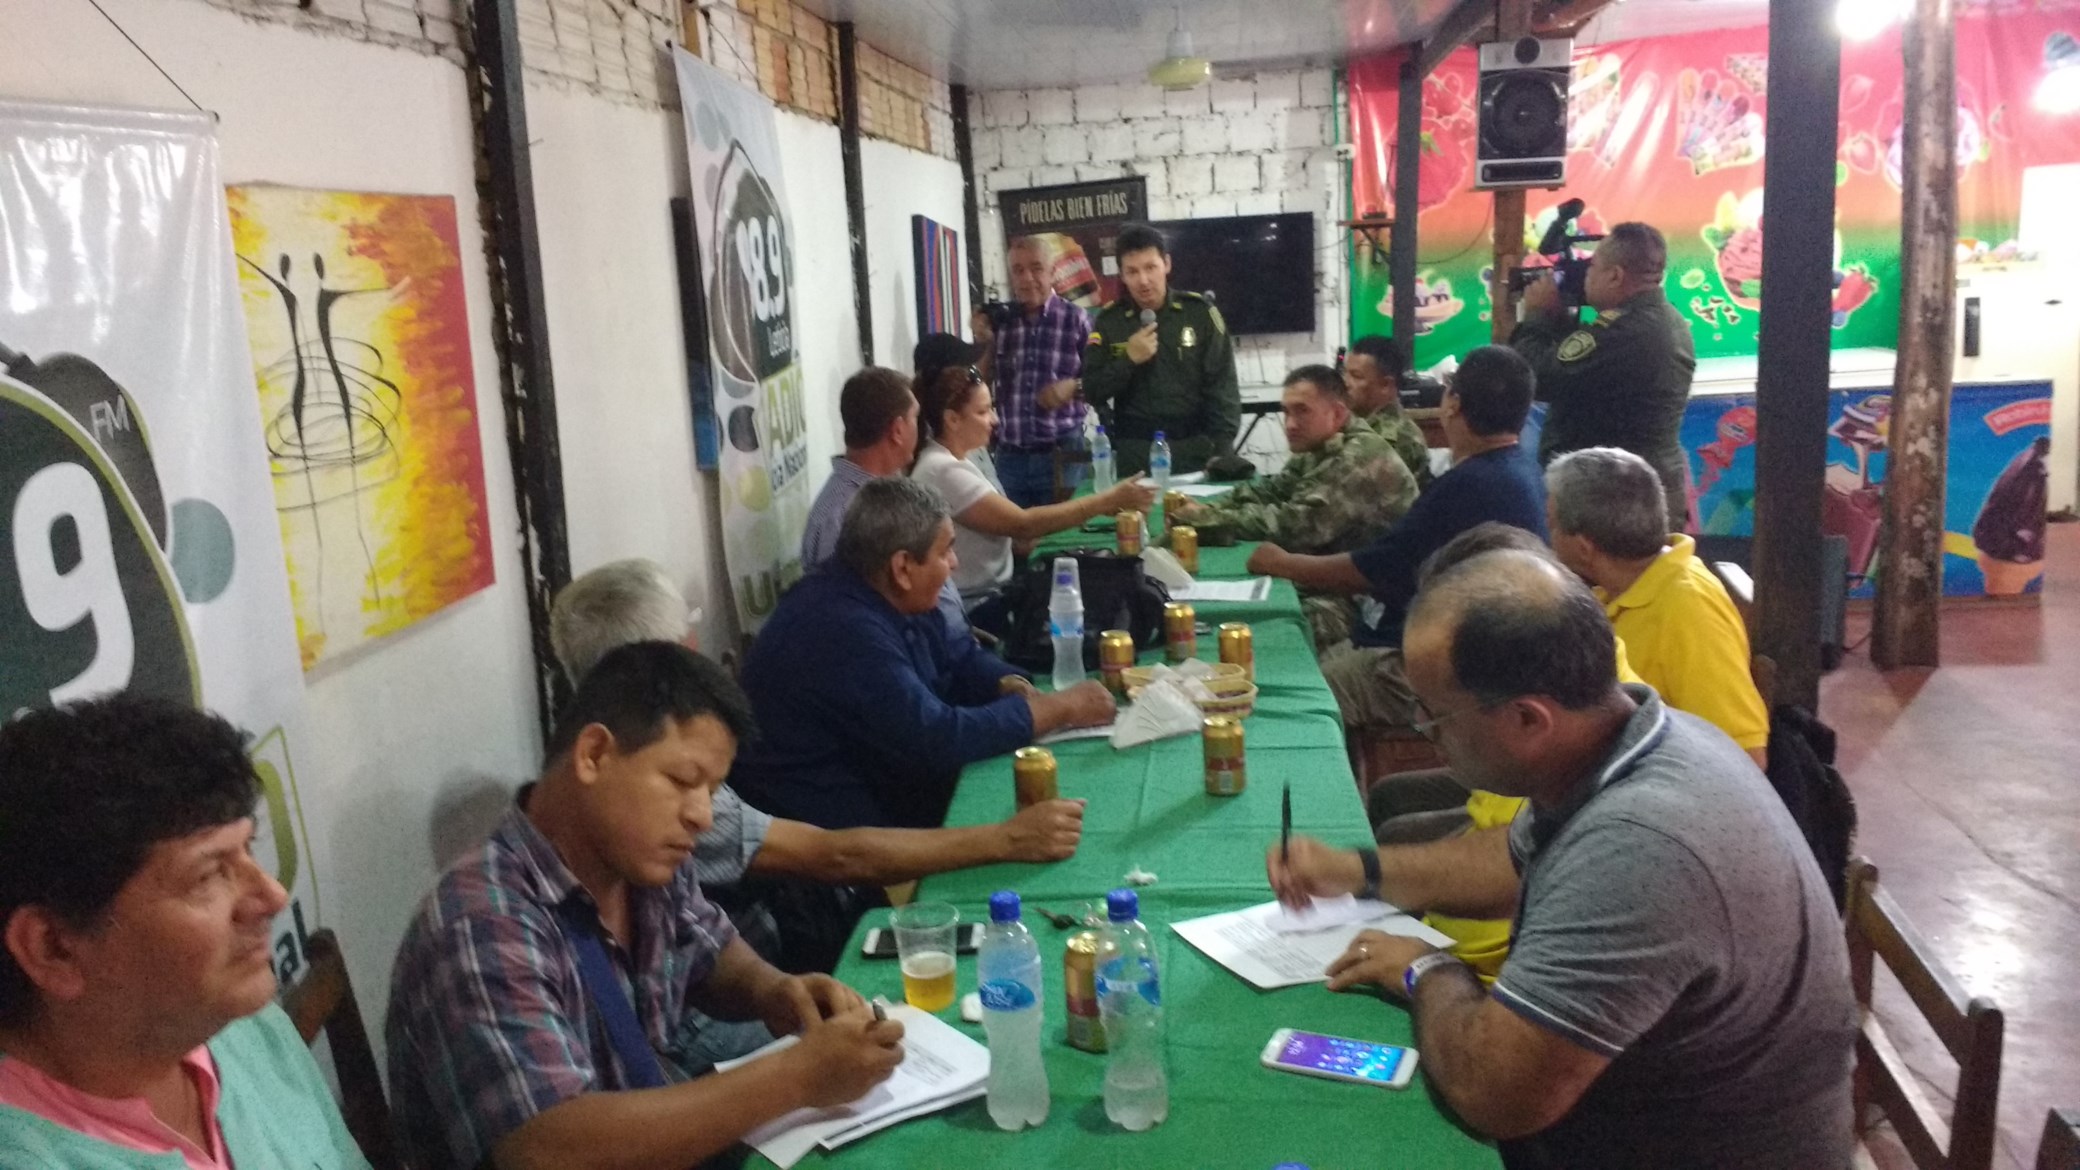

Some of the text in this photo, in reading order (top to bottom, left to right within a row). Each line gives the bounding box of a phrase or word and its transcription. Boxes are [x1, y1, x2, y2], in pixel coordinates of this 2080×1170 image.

[1020, 190, 1128, 225] PÍDELAS BIEN FRÍAS
[90, 394, 130, 441] FM
